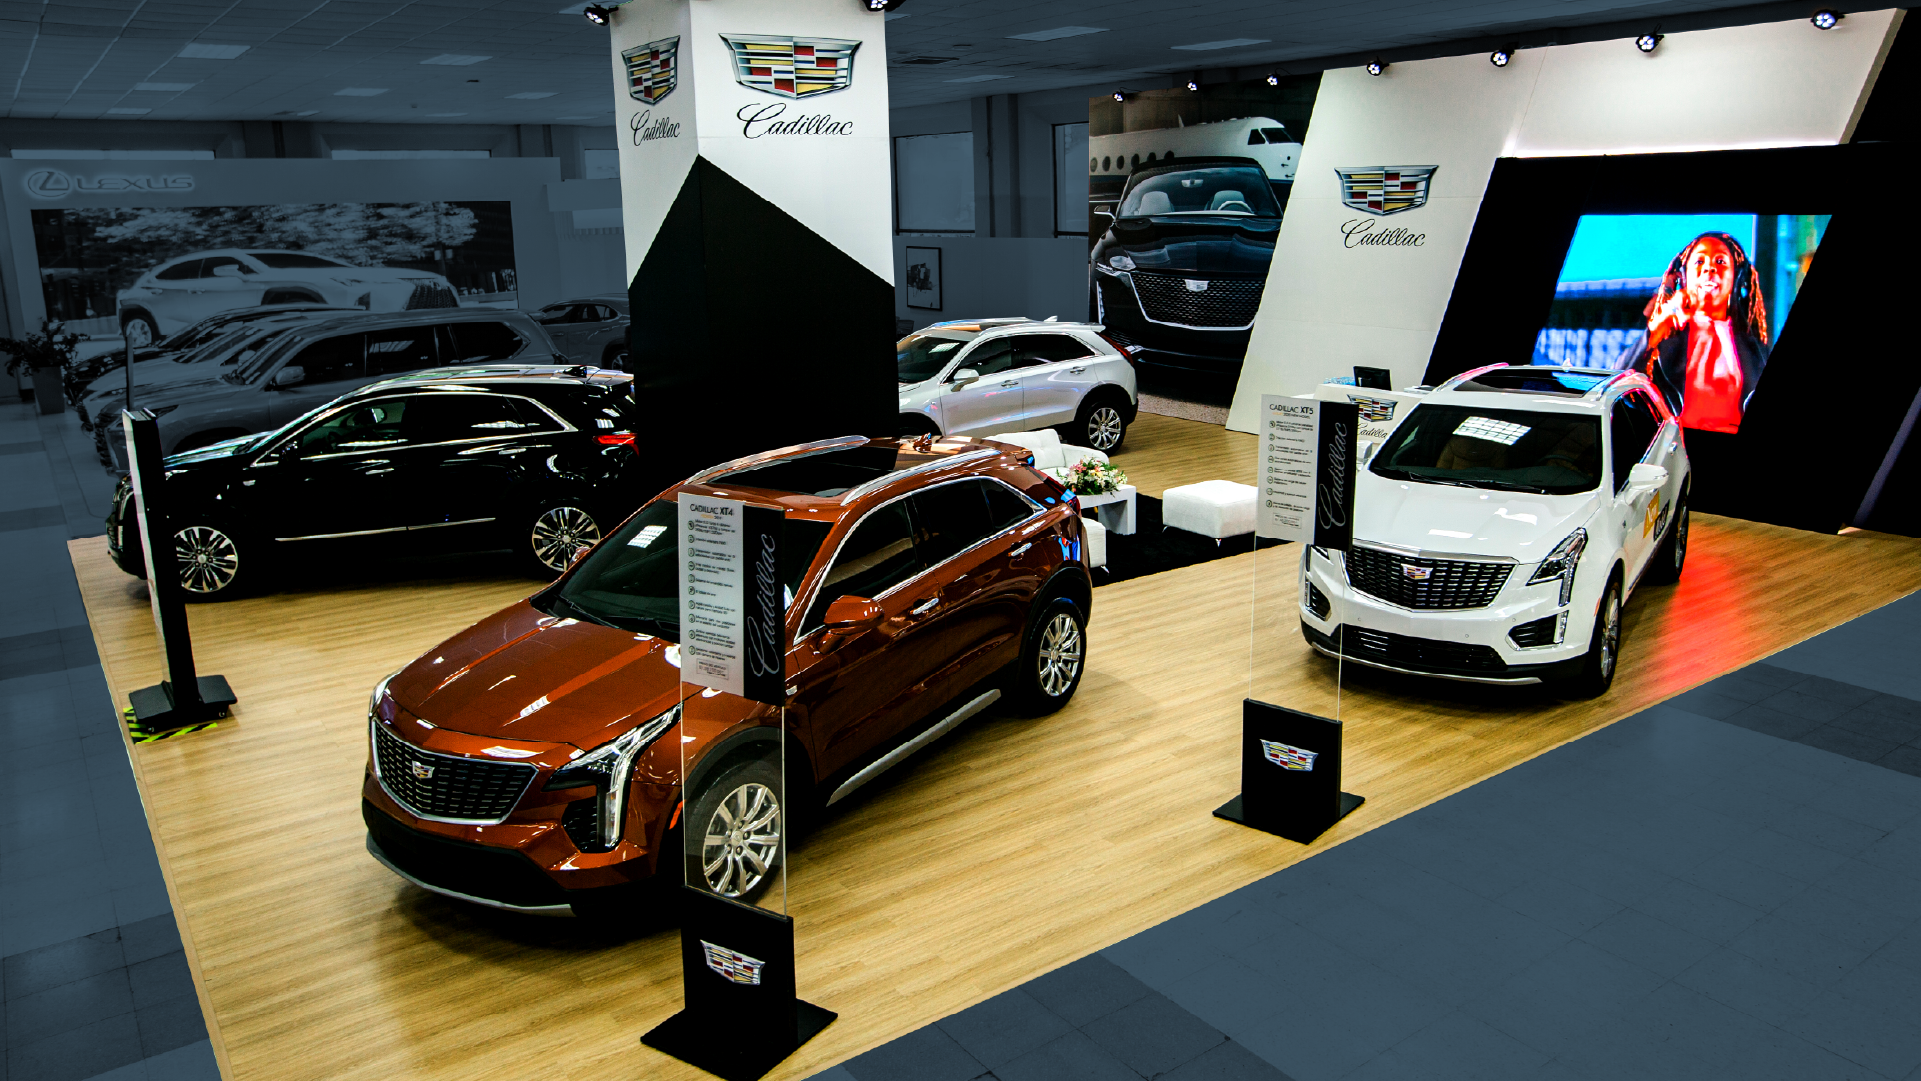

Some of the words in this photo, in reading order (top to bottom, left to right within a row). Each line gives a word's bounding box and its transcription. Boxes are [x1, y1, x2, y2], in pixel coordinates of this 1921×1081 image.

[631, 110, 680, 146] Cadillac
[737, 103, 854, 139] Cadillac
[77, 176, 193, 191] LEXUS
[1341, 218, 1426, 249] Cadillac
[1269, 403, 1299, 413] CADILLAC
[1300, 406, 1314, 415] XT5
[1358, 422, 1388, 439] adilla
[1317, 422, 1348, 529] Cadillac
[689, 503, 719, 515] CADILLAC
[719, 507, 734, 517] XT4
[747, 533, 780, 677] Cadillac
